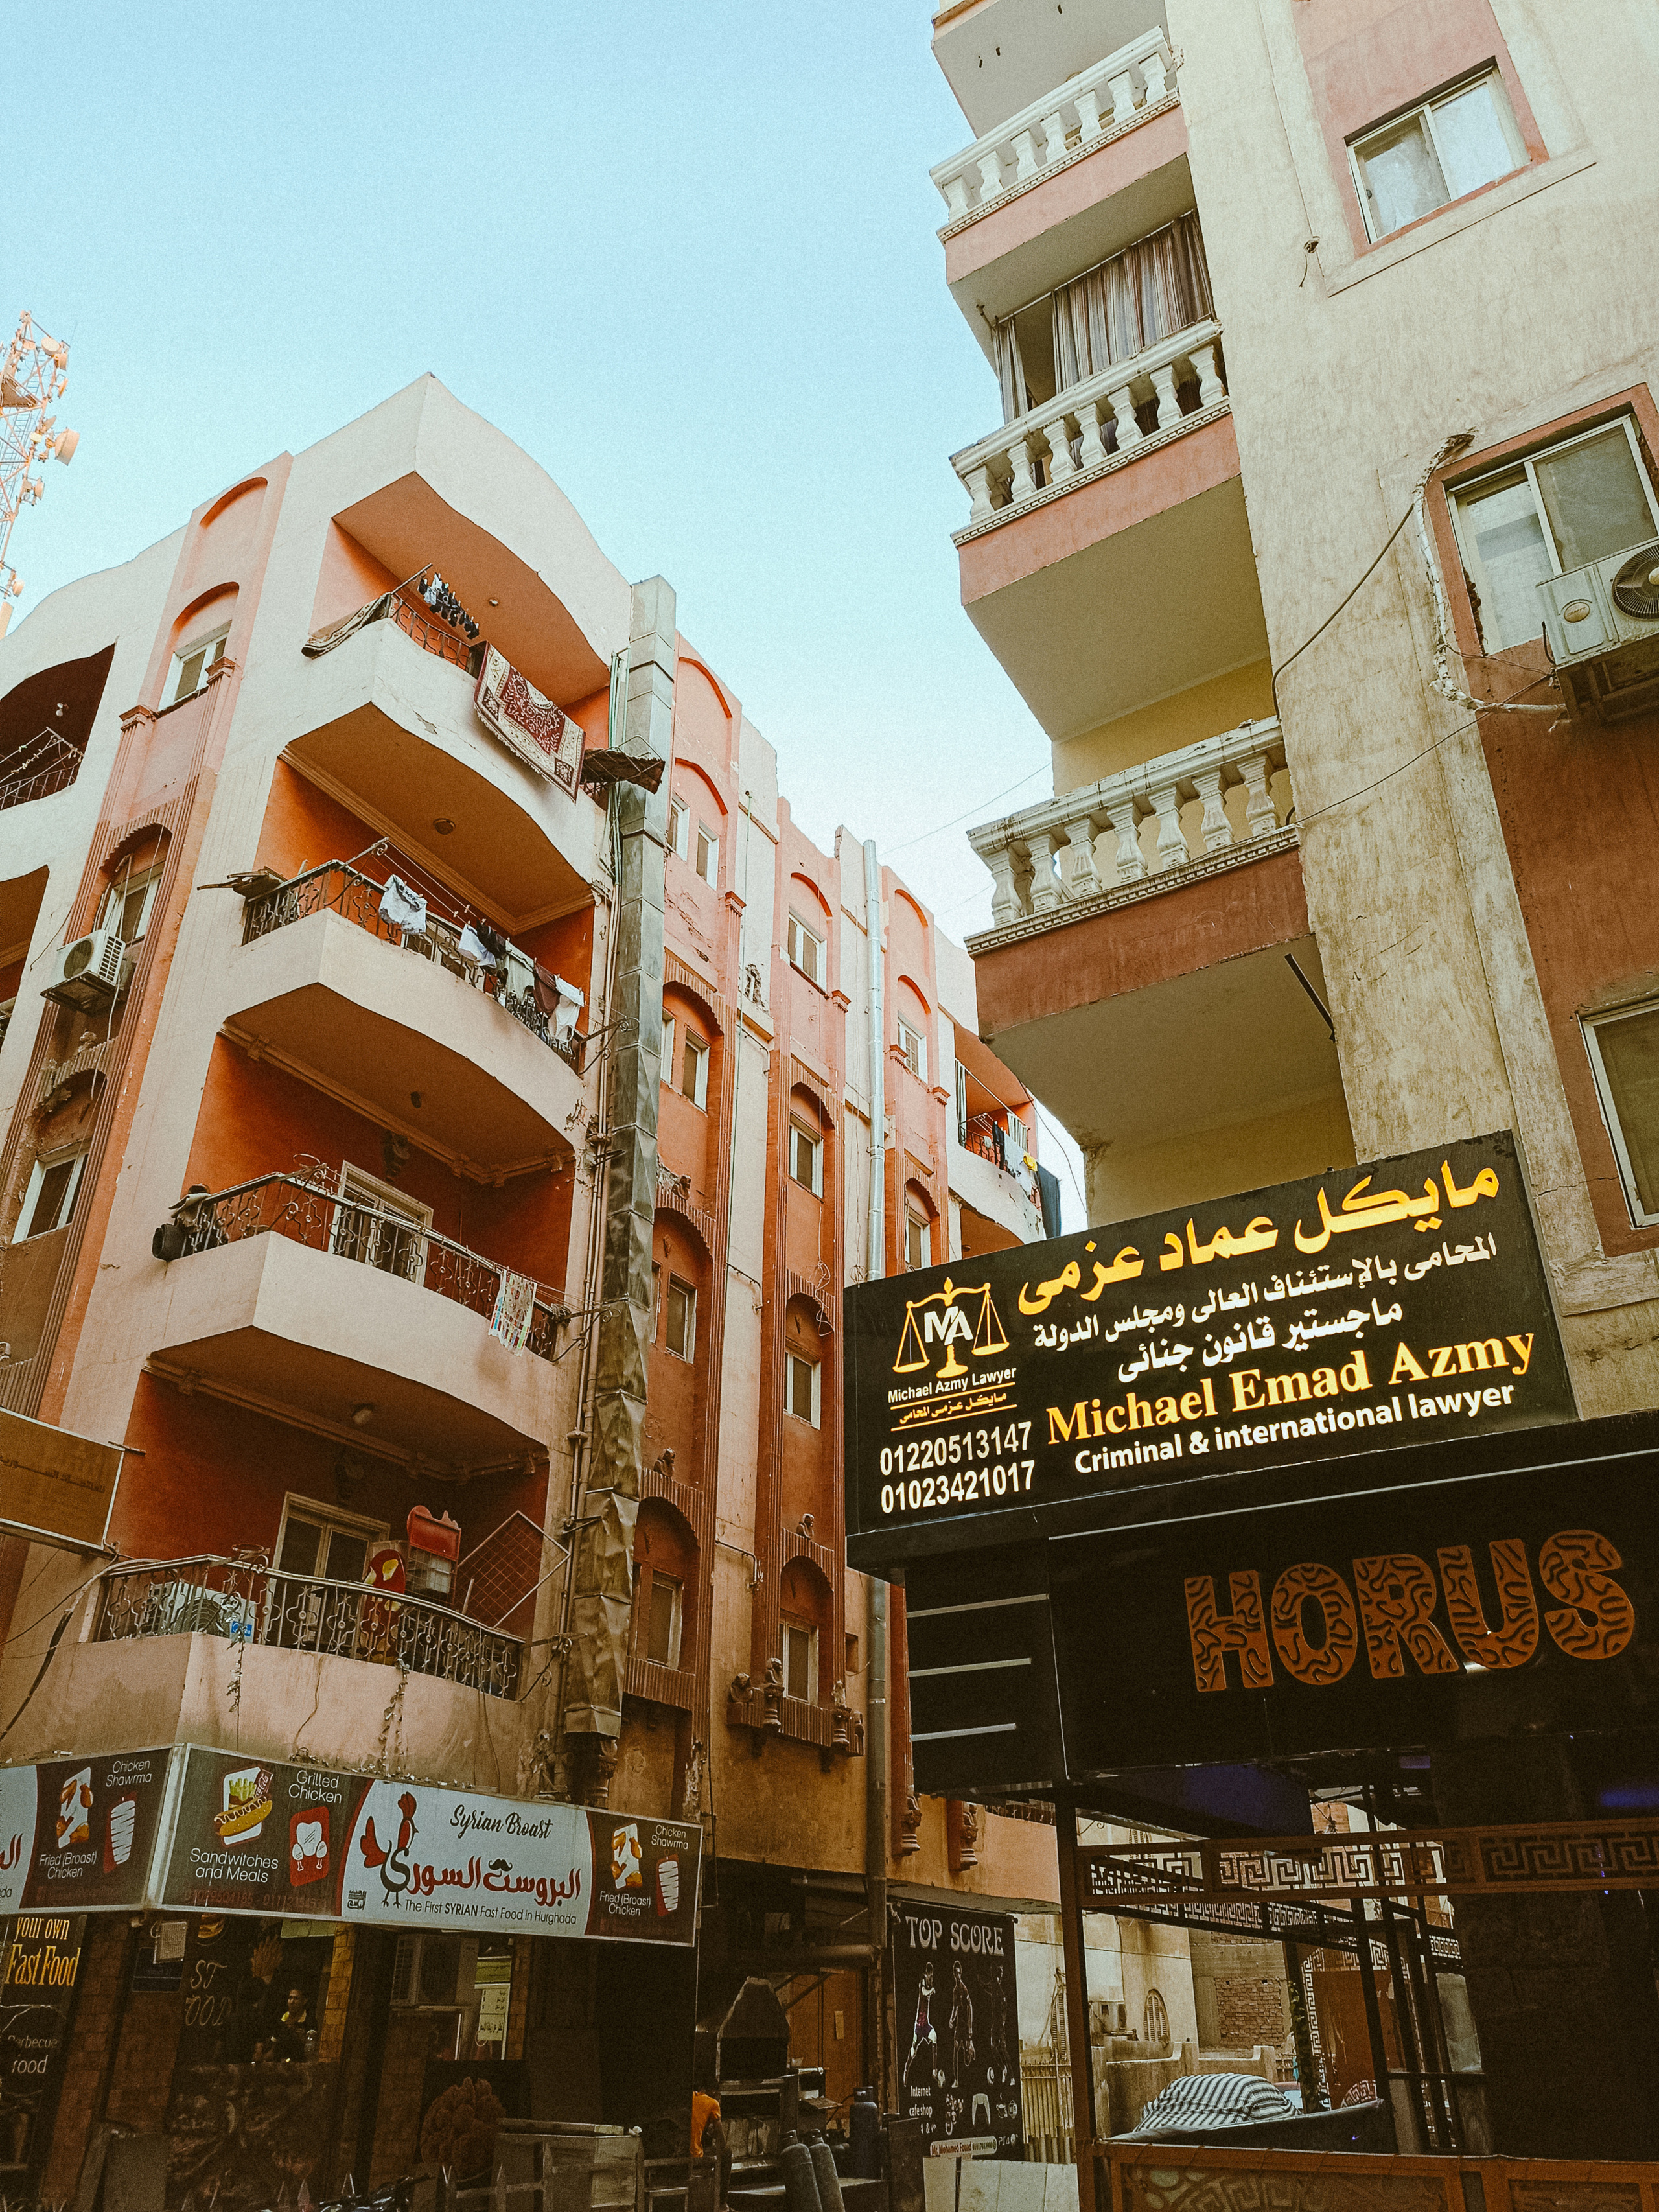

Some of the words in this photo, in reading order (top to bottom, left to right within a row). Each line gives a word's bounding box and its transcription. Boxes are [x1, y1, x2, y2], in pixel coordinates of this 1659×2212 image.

[1294, 1160, 1499, 1254] مايكل
[1159, 1216, 1279, 1271] عماد
[924, 1306, 973, 1345] MA
[1034, 1314, 1099, 1351] الدولة
[1105, 1303, 1185, 1342] ومجلس
[1281, 1298, 1403, 1351] ماجستير
[1202, 1316, 1275, 1366] قانون
[888, 1382, 933, 1404] Michael
[935, 1377, 969, 1394] Azmy
[972, 1368, 1017, 1388] Lawyer
[1046, 1378, 1218, 1445] Michael
[1229, 1350, 1373, 1412] Emad
[1388, 1333, 1534, 1385] Azmy
[965, 1393, 1007, 1411] مايكل
[1074, 1434, 1183, 1474] Criminal
[1189, 1431, 1210, 1456] &
[1214, 1396, 1402, 1450] international
[1408, 1384, 1514, 1418] lawyer
[880, 1421, 1032, 1476] 01220513147
[881, 1460, 1036, 1513] 01023421017
[1183, 1529, 1636, 1693] HORUS
[106, 1772, 152, 1787] Shawrma
[113, 1760, 150, 1774] Chicken
[296, 1770, 340, 1789] Grilled
[288, 1784, 342, 1804] Chicken
[450, 1804, 504, 1839] Syrian
[505, 1812, 553, 1839] Broast
[655, 1824, 686, 1839] Chicken
[651, 1835, 688, 1850] Shawrma
[39, 1853, 61, 1866] Fried
[62, 1851, 97, 1866] (Broast)
[189, 1848, 279, 1869] Sandwitches
[47, 1866, 83, 1880] Chicken
[195, 1865, 224, 1880] and
[226, 1867, 269, 1883] Meals
[599, 1891, 620, 1902] Fried
[609, 1903, 640, 1916] Chicken
[405, 1899, 422, 1912] The
[424, 1901, 443, 1913] First
[444, 1902, 478, 1916] SYRIAN
[480, 1906, 498, 1918] Fast
[500, 1907, 523, 1920] Food
[525, 1909, 533, 1921] in
[534, 1910, 576, 1925] Hurghada
[14, 1917, 45, 1942] your
[45, 1918, 70, 1940] own
[905, 1916, 943, 1950] TOP
[950, 1922, 1004, 1957] SCORE
[5, 1944, 41, 1985] Fast
[38, 1946, 81, 1986] Food
[910, 2086, 931, 2097] Internet
[909, 2104, 920, 2117] cafe
[920, 2104, 933, 2118] shop
